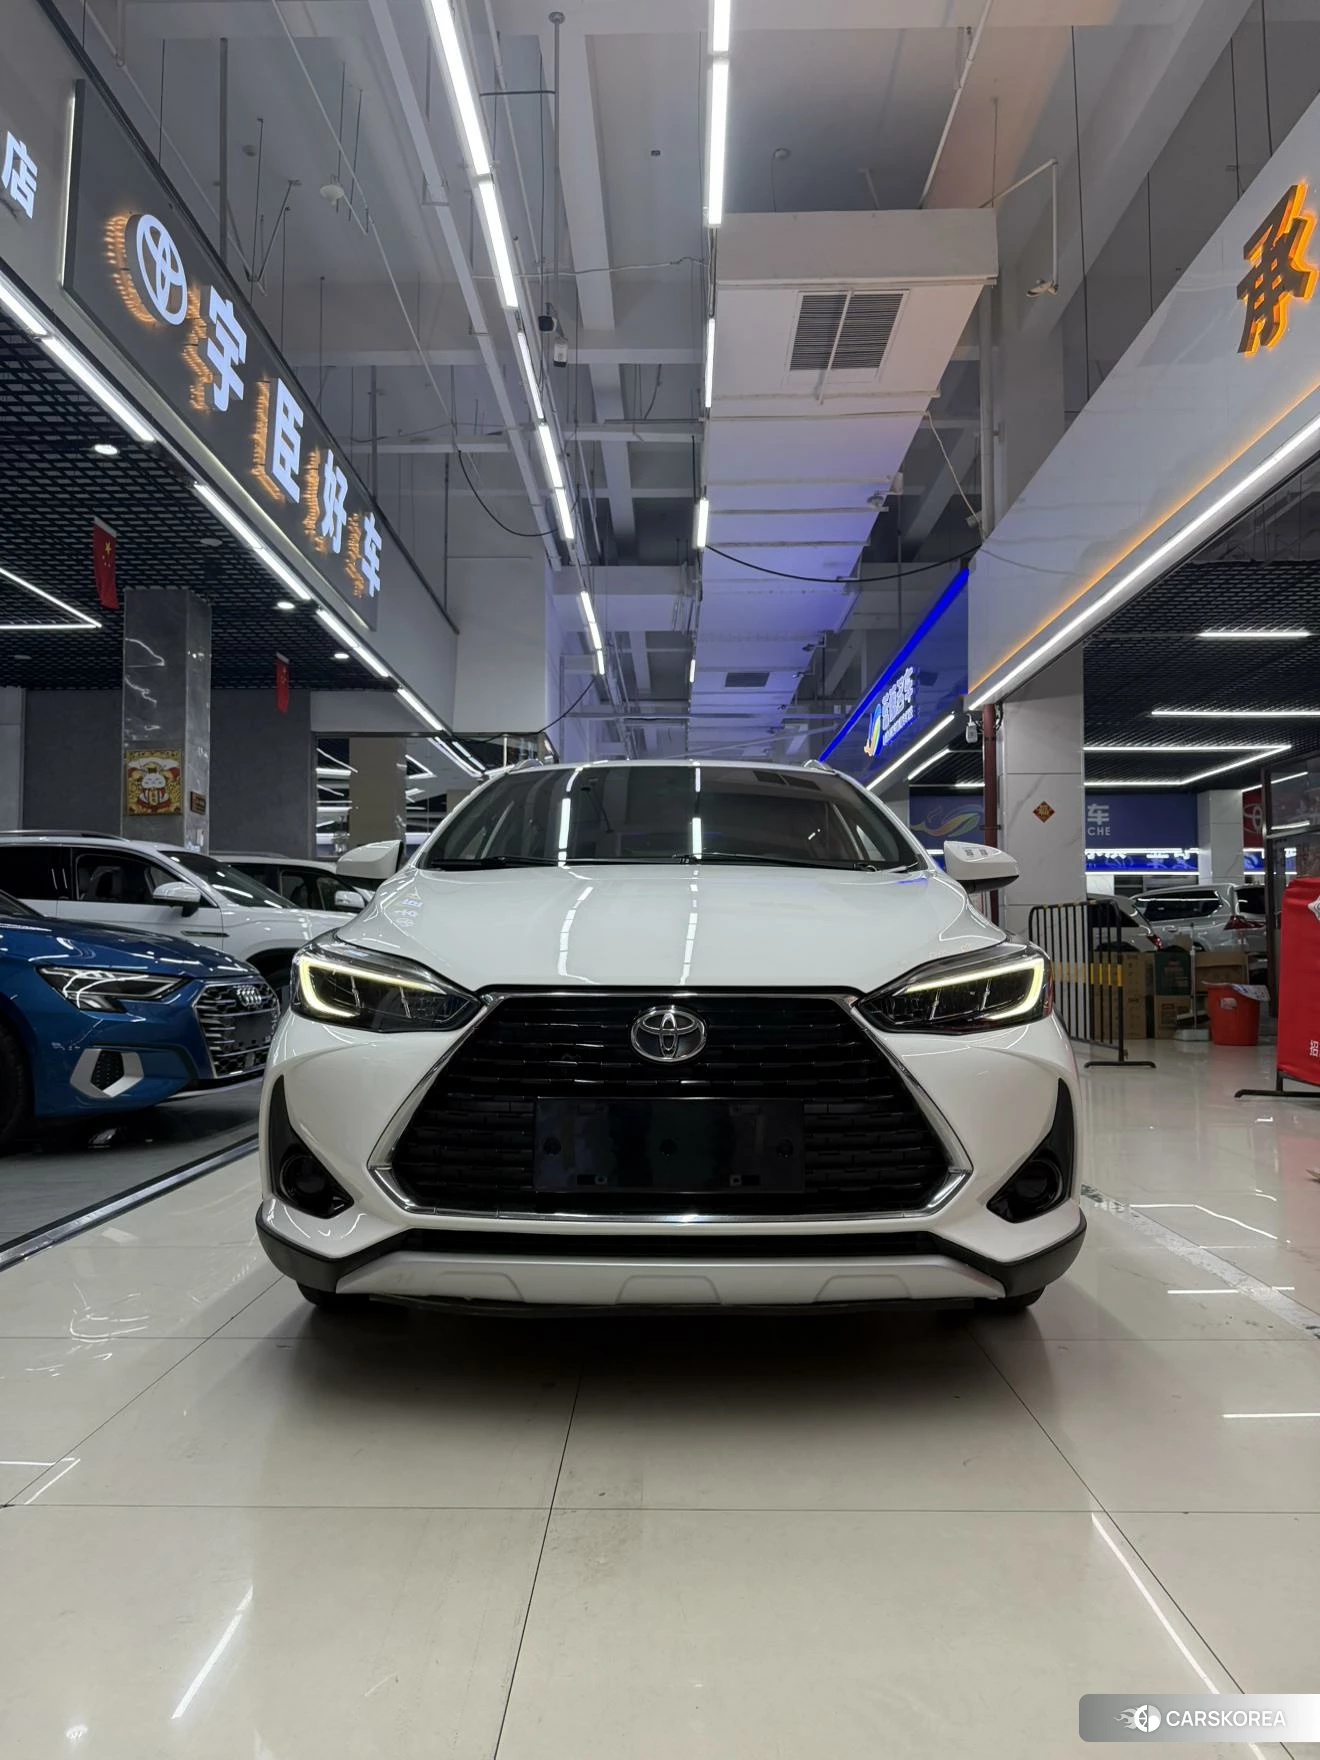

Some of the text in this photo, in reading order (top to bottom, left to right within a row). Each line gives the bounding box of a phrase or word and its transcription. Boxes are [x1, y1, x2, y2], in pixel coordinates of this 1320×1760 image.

[1, 131, 38, 219] 店
[1237, 184, 1317, 354] 承
[207, 285, 382, 598] 宇臣好车
[1086, 803, 1109, 825] 车
[1087, 826, 1110, 836] CHE
